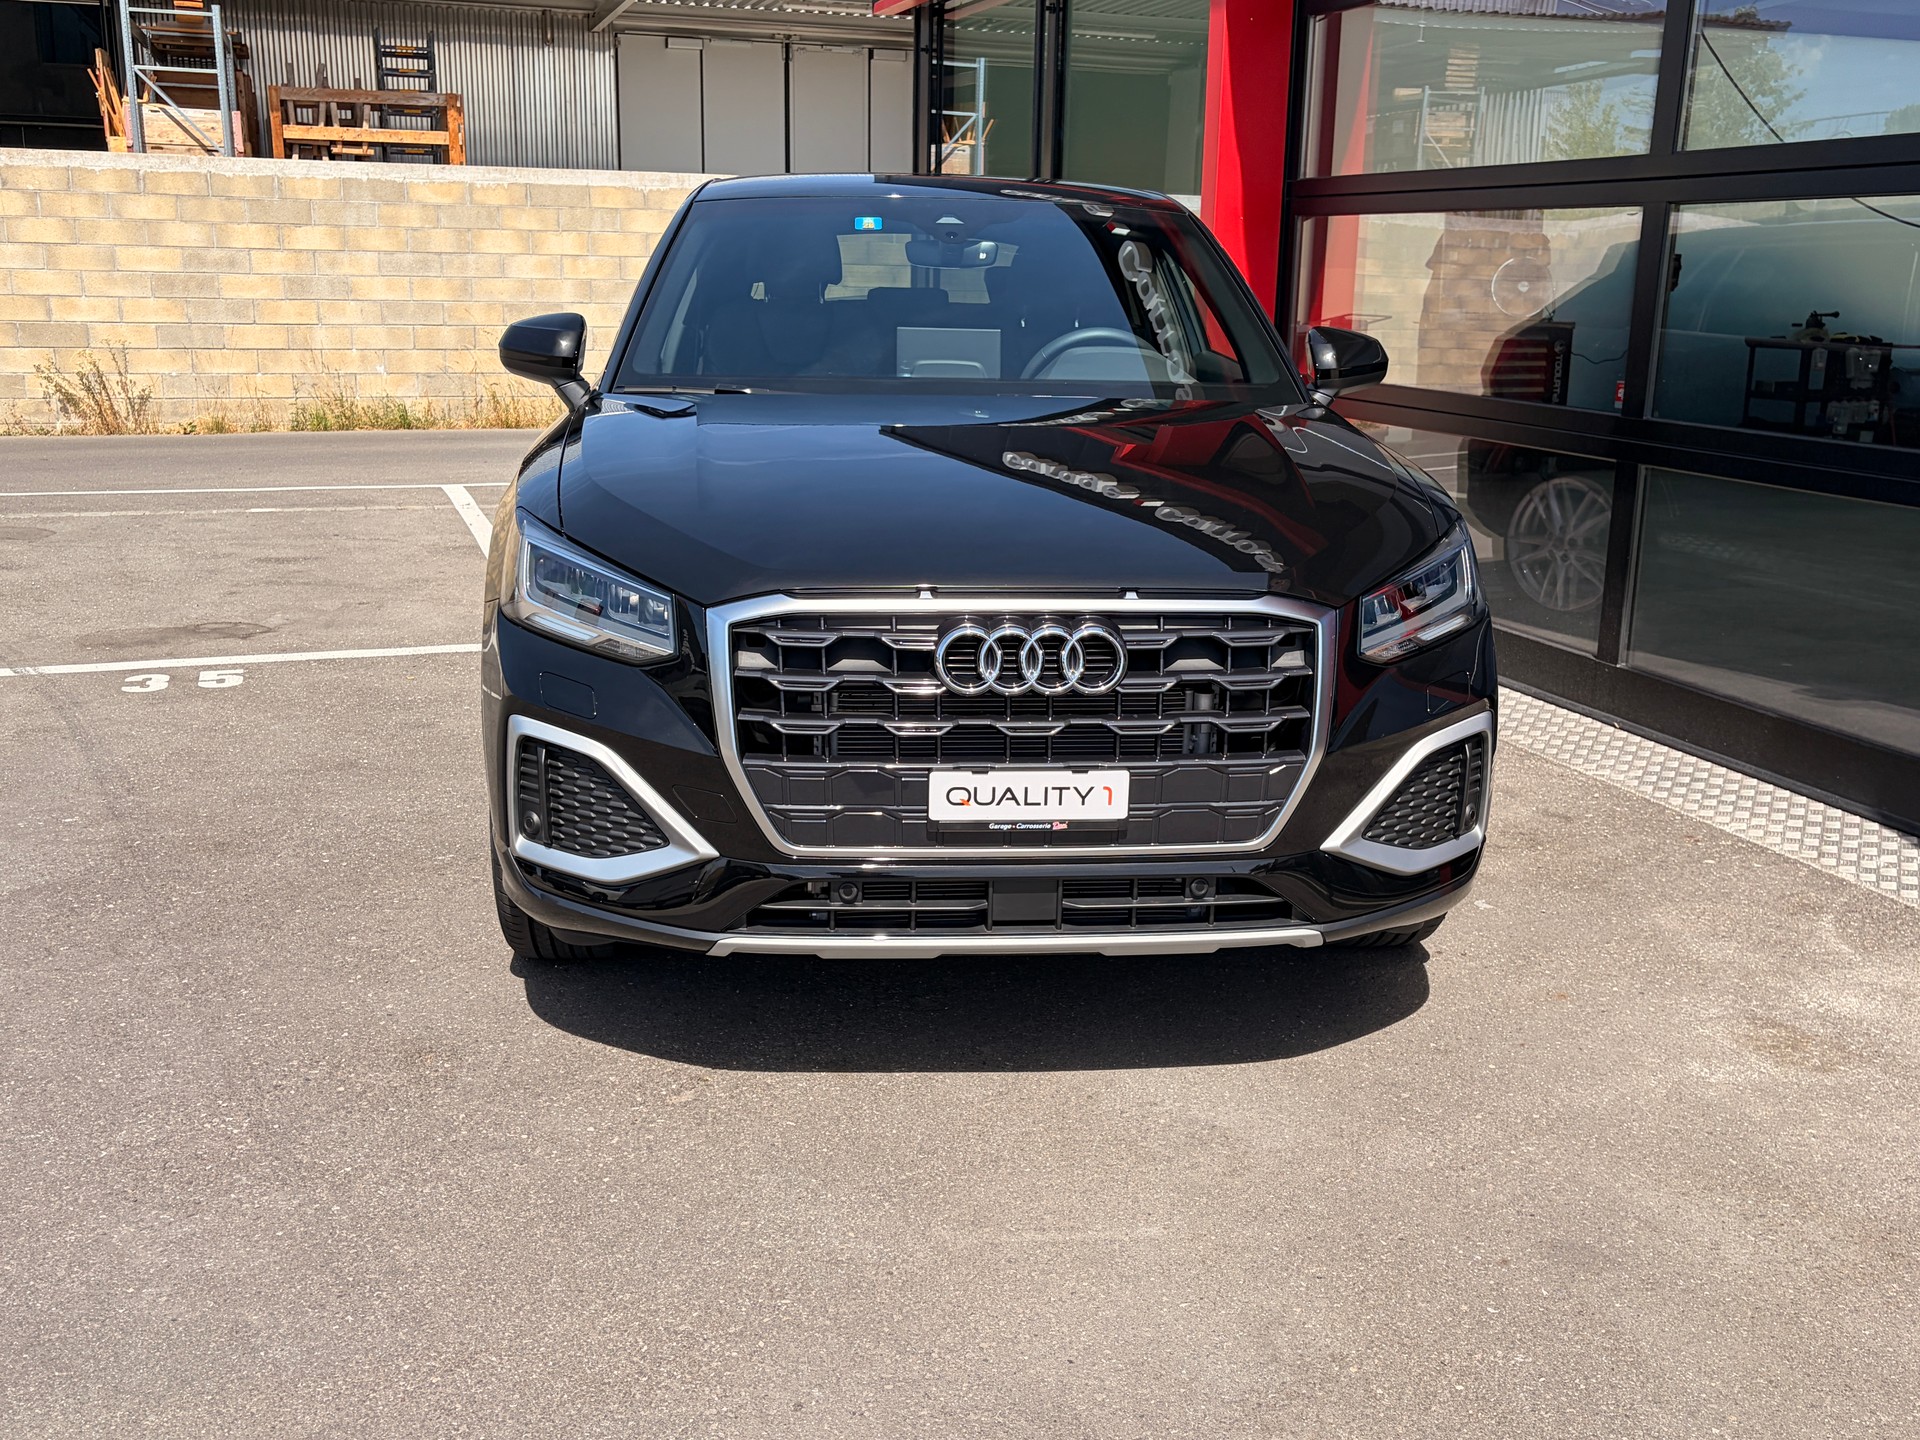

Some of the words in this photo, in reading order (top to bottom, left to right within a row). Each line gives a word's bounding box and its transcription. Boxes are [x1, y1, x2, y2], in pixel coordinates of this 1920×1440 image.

[946, 786, 1095, 806] QUALITY
[1103, 786, 1113, 806] 1
[989, 823, 1012, 831] Garage
[1016, 822, 1051, 830] Carrosserie
